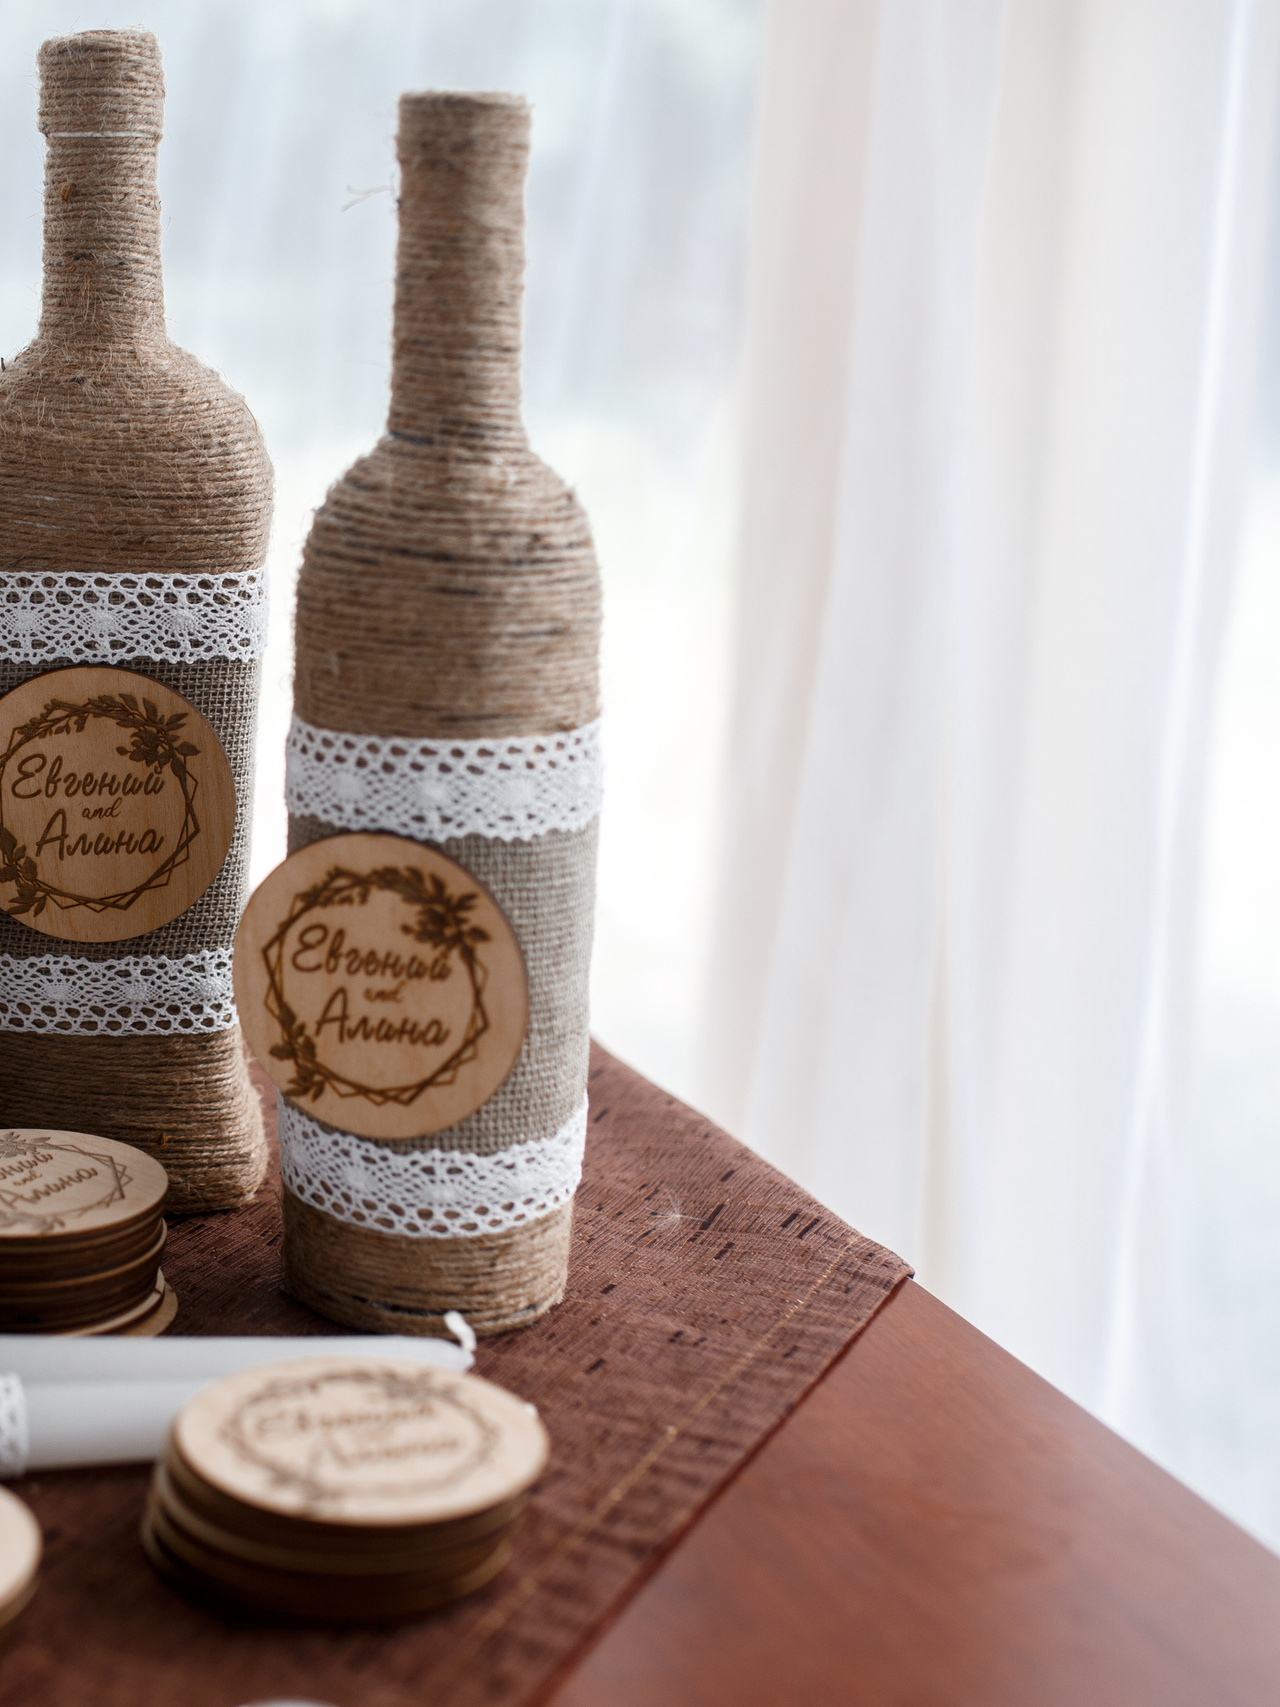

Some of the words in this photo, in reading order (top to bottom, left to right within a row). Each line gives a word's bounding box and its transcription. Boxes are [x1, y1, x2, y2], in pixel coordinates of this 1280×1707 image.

[11, 753, 165, 800] Евгений
[81, 796, 122, 820] and
[35, 808, 165, 861] Алина
[315, 986, 451, 1047] Алина
